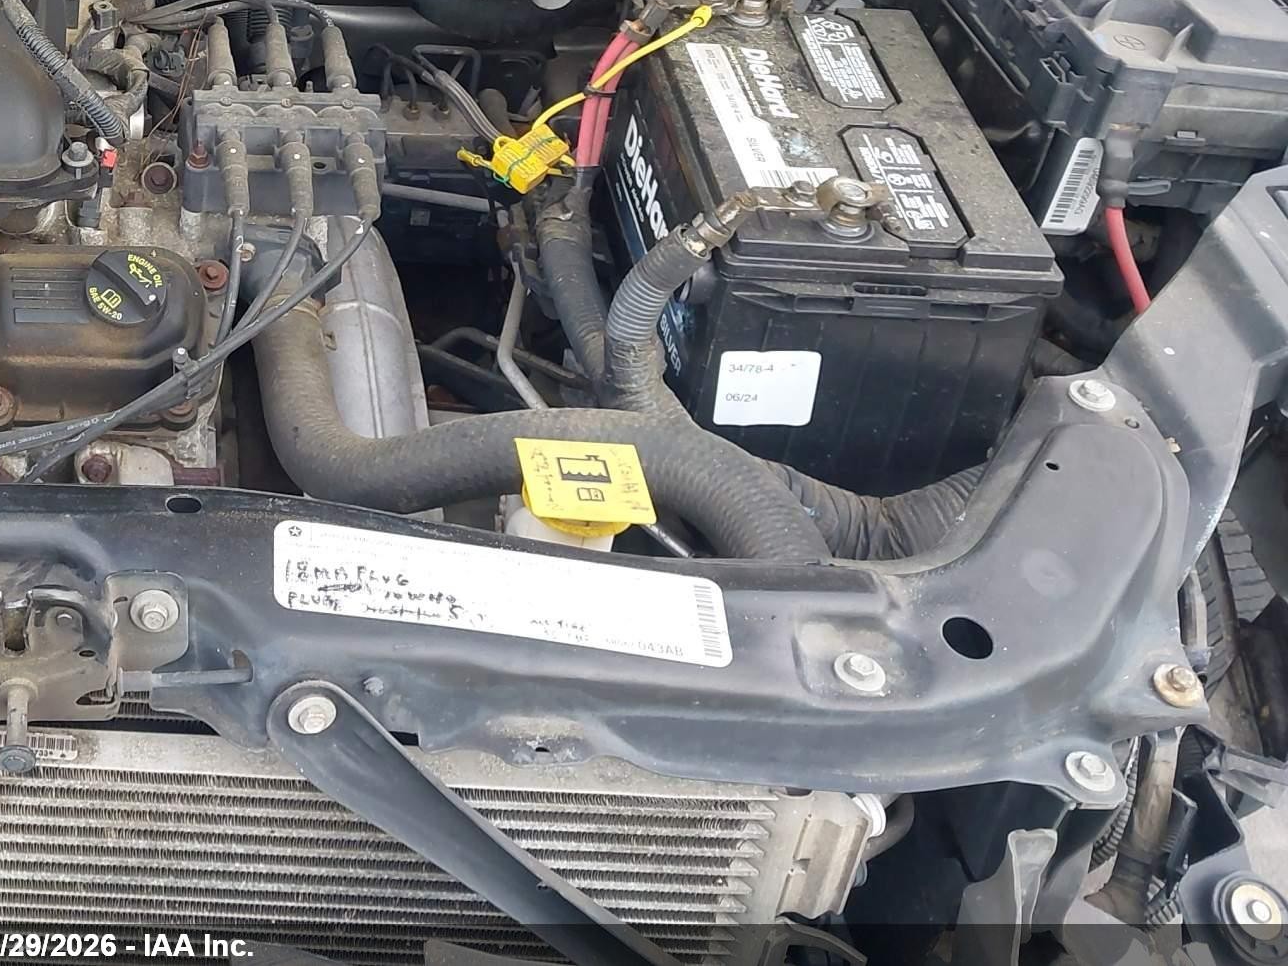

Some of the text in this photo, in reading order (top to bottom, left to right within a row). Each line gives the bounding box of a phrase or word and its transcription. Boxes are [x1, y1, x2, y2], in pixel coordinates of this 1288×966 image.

[740, 47, 800, 119] DieHard
[746, 137, 766, 163] SILVER
[624, 113, 669, 241] DieHar
[127, 254, 163, 288] ENGINE OIL
[97, 303, 123, 320] 5W-20
[661, 313, 682, 377] SILVER
[725, 392, 758, 402] 06/24
